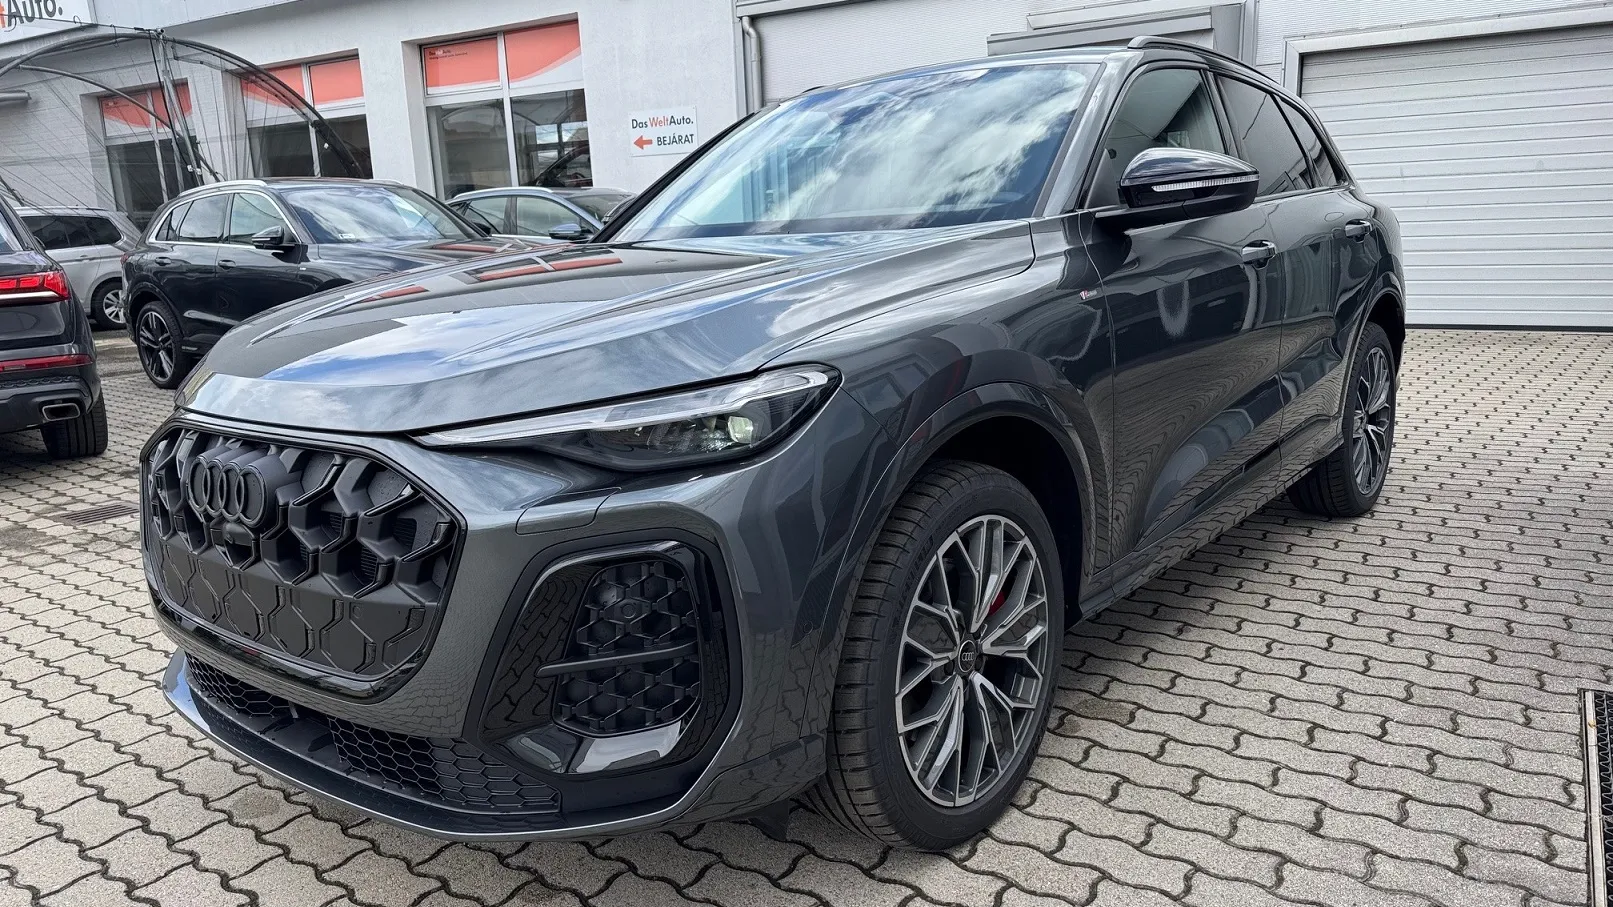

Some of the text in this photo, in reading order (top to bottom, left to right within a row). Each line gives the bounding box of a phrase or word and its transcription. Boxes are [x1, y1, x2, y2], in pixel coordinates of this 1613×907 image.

[631, 115, 694, 129] Das WeltAuto.
[656, 133, 694, 146] BEJÁRAT
